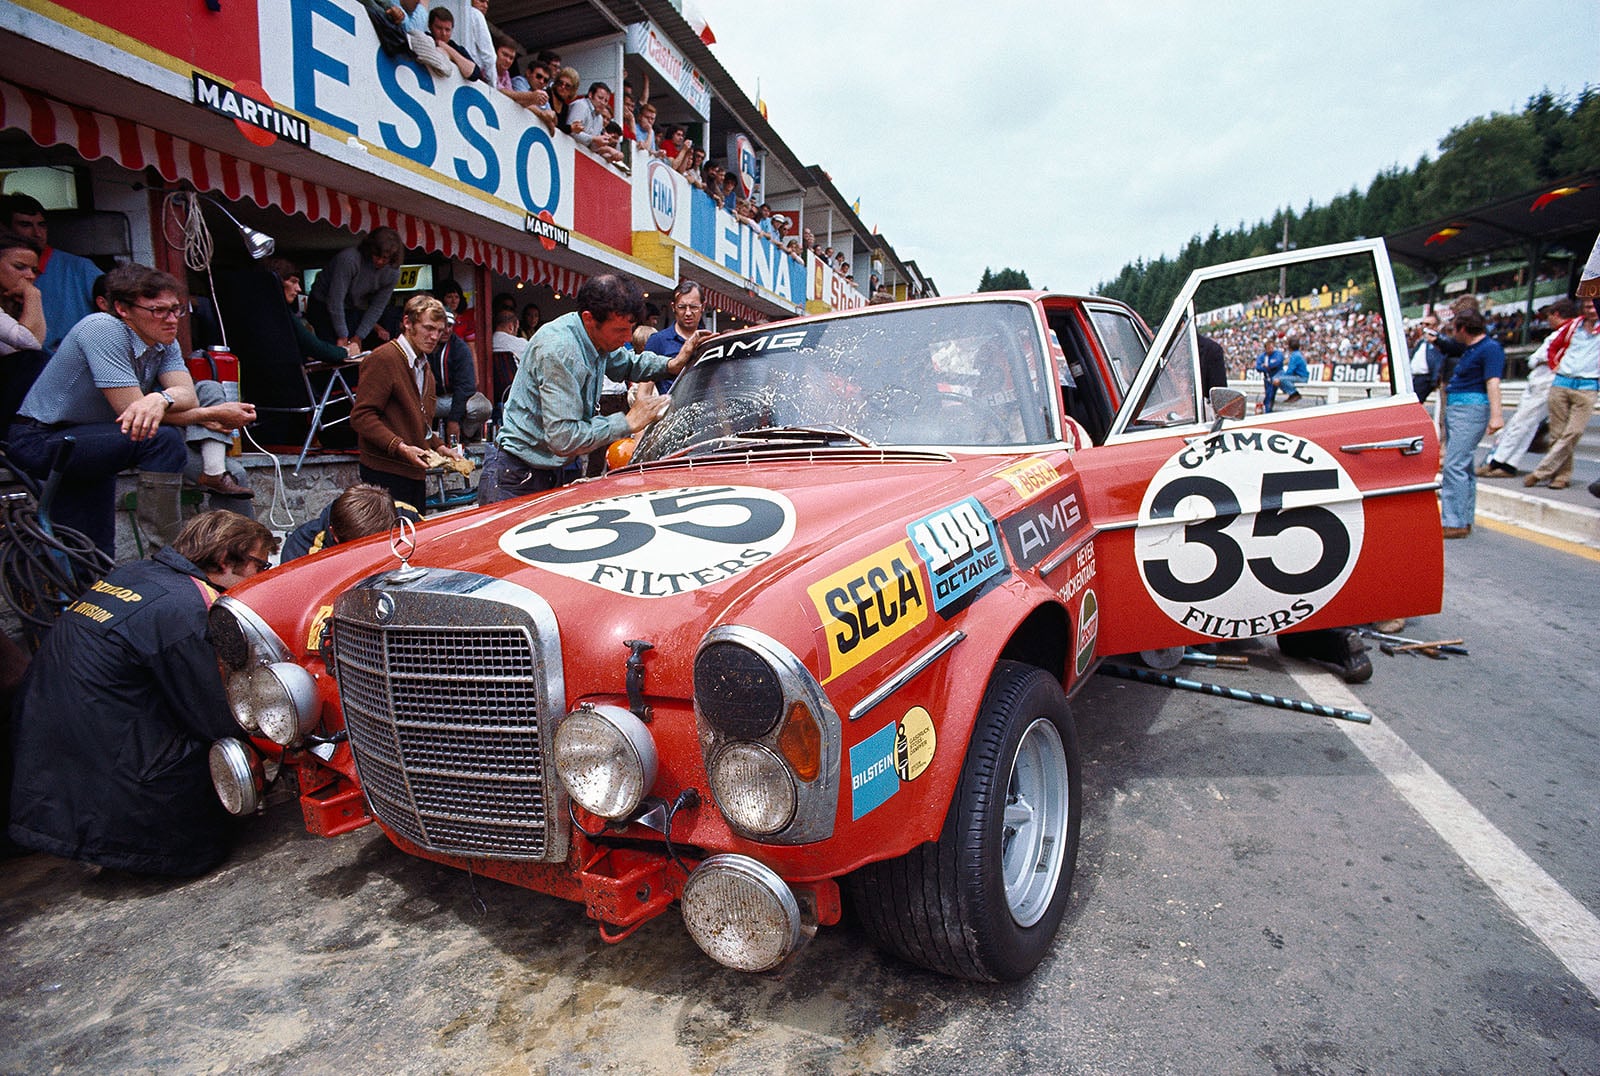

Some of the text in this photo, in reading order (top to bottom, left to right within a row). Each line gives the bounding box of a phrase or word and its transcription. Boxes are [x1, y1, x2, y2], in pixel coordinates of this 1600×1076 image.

[199, 77, 309, 145] MARTINI
[292, 0, 561, 217] ESSO
[653, 178, 673, 218] FINA
[526, 214, 569, 246] MARTINI
[715, 206, 793, 302] FINA
[695, 331, 808, 366] AMG
[1333, 364, 1379, 383] Shell
[1179, 432, 1314, 470] CAMEL
[1017, 460, 1059, 494] BOSCH
[515, 486, 786, 564] 35
[913, 503, 992, 573] 100
[1018, 493, 1082, 560] AMG
[1142, 468, 1352, 603] 35
[588, 548, 773, 597] FILTERS
[935, 551, 999, 599] OCTANE
[824, 557, 923, 655] SECA
[1180, 599, 1315, 638] FILTERS
[852, 752, 894, 790] BILSTEIN
